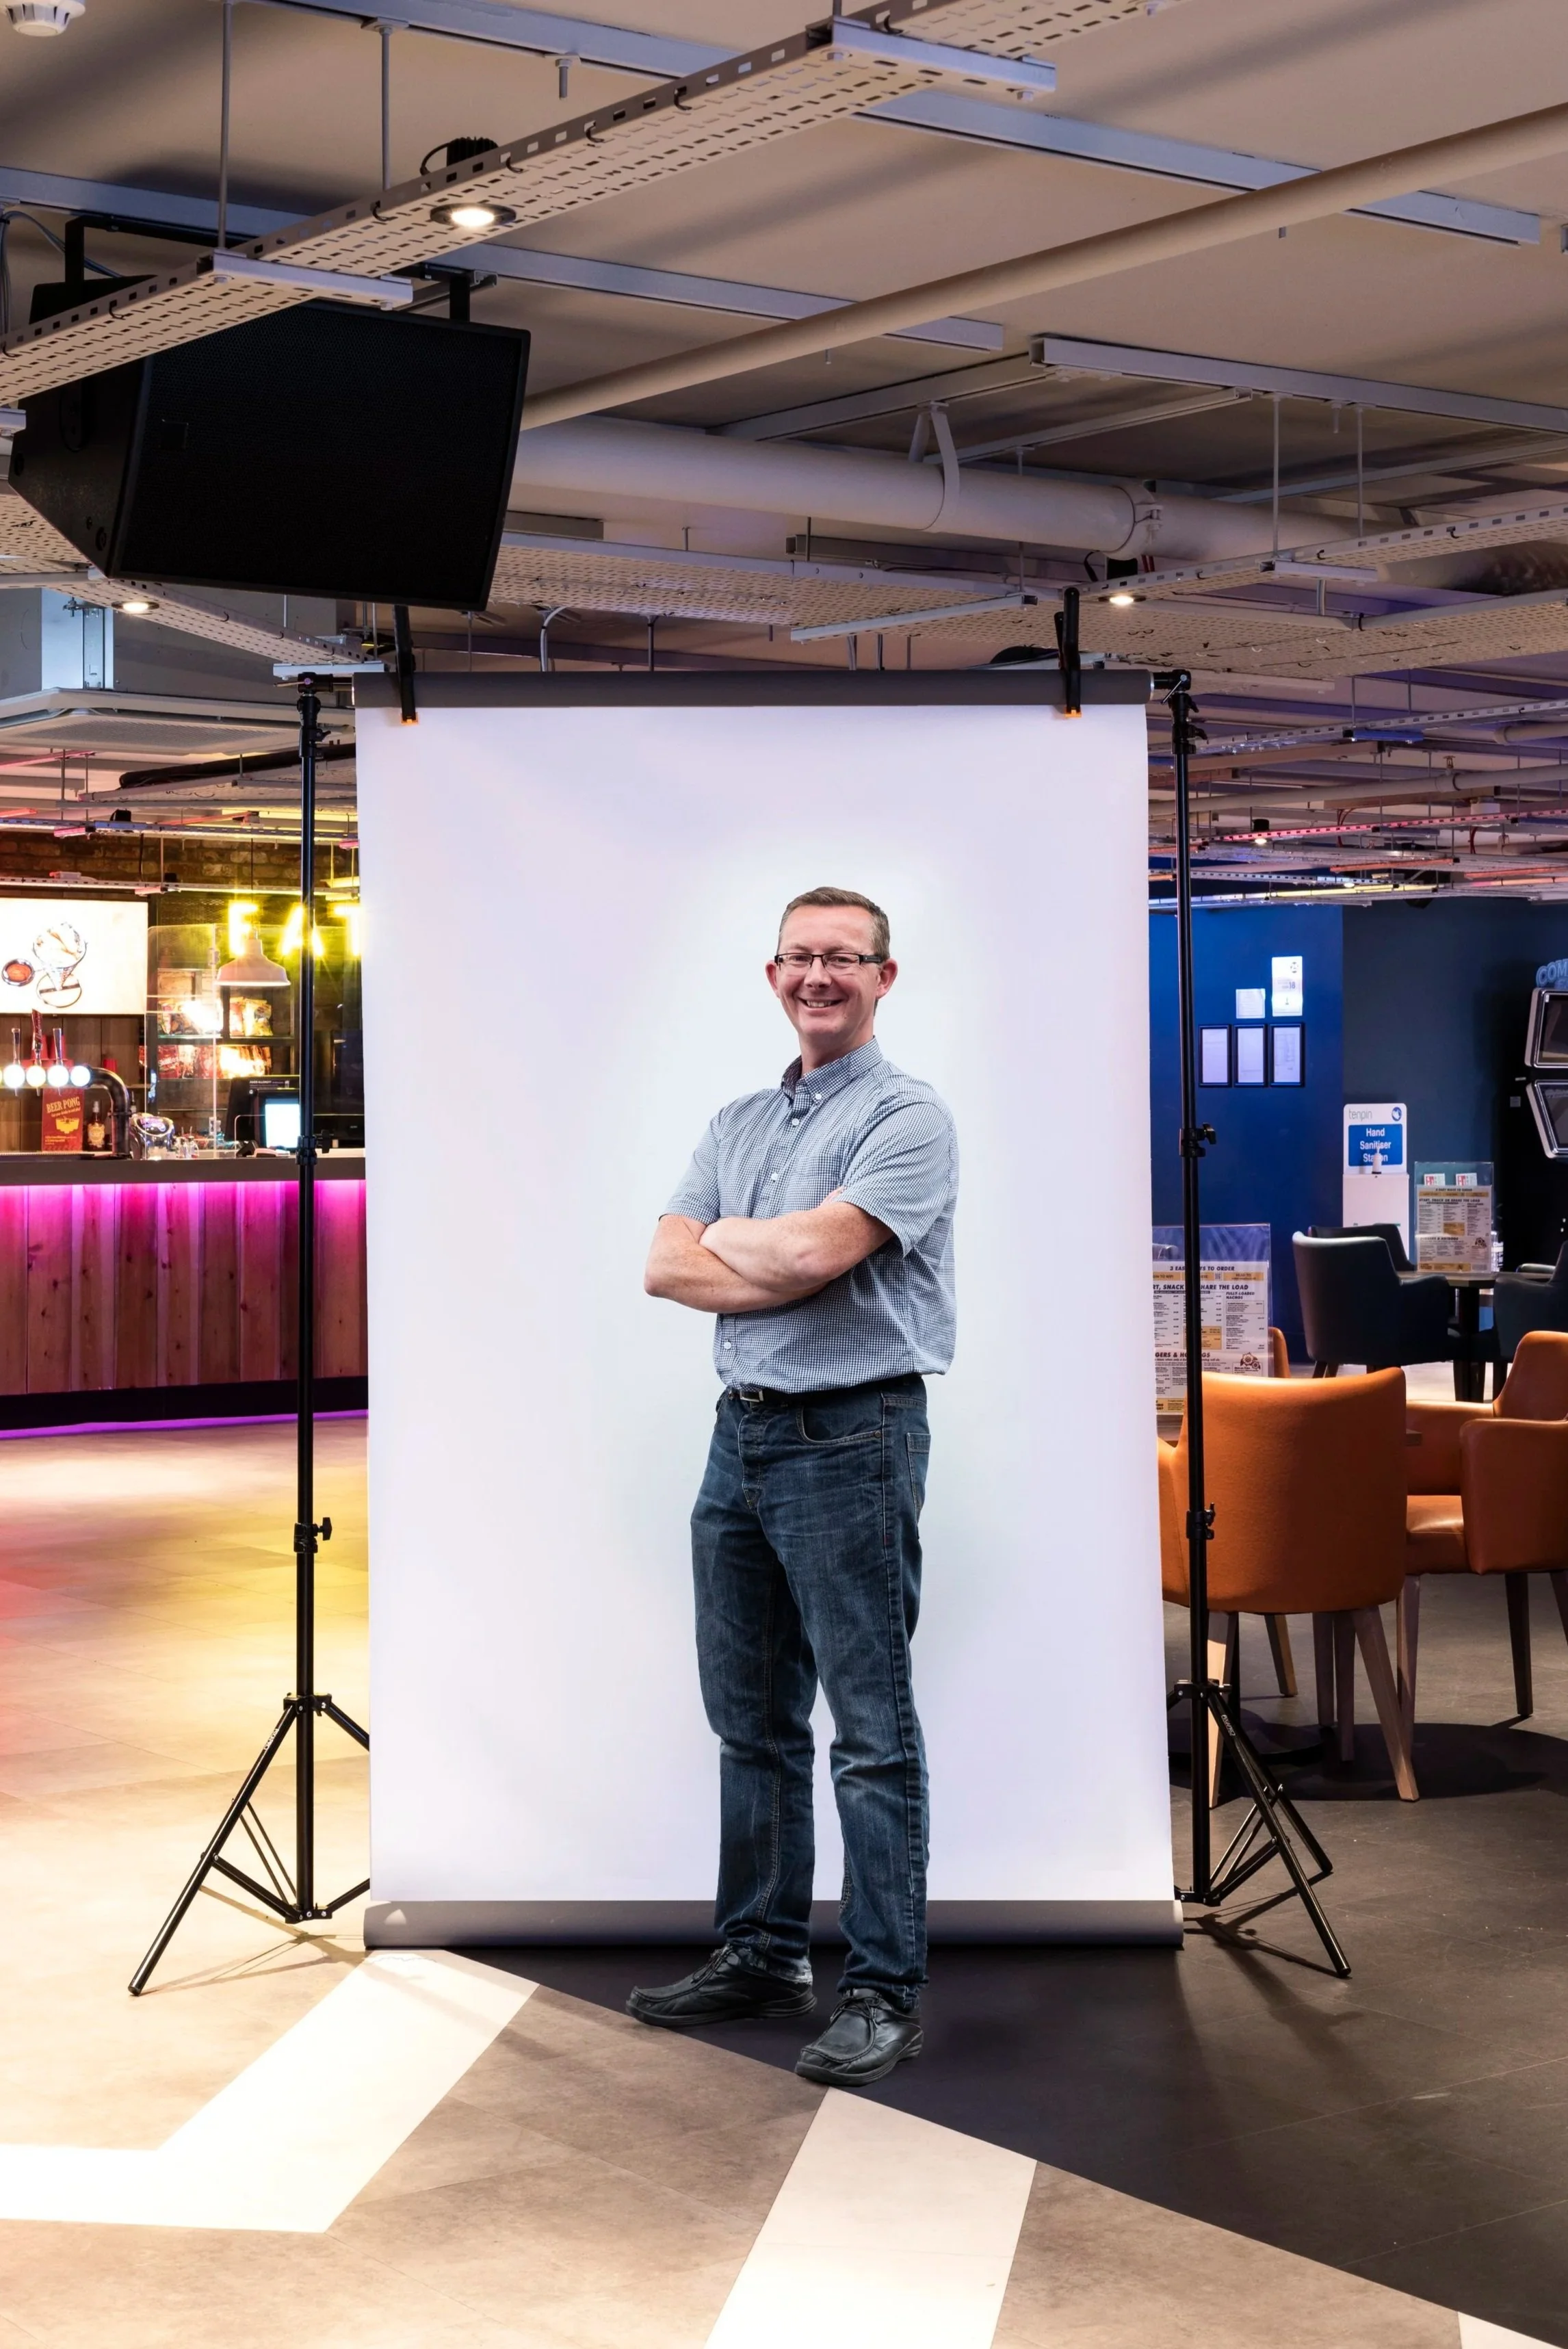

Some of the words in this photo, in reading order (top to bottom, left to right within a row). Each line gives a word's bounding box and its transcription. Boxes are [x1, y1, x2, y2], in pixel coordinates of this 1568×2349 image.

[229, 901, 361, 957] EAT
[1536, 959, 1568, 987] COM
[46, 1101, 62, 1113] BEER
[62, 1097, 80, 1108] PONG
[1348, 1108, 1372, 1121] tenpin
[1366, 1128, 1385, 1137] Hand
[1359, 1141, 1391, 1150] Sanitiser
[1363, 1154, 1388, 1162] Stan
